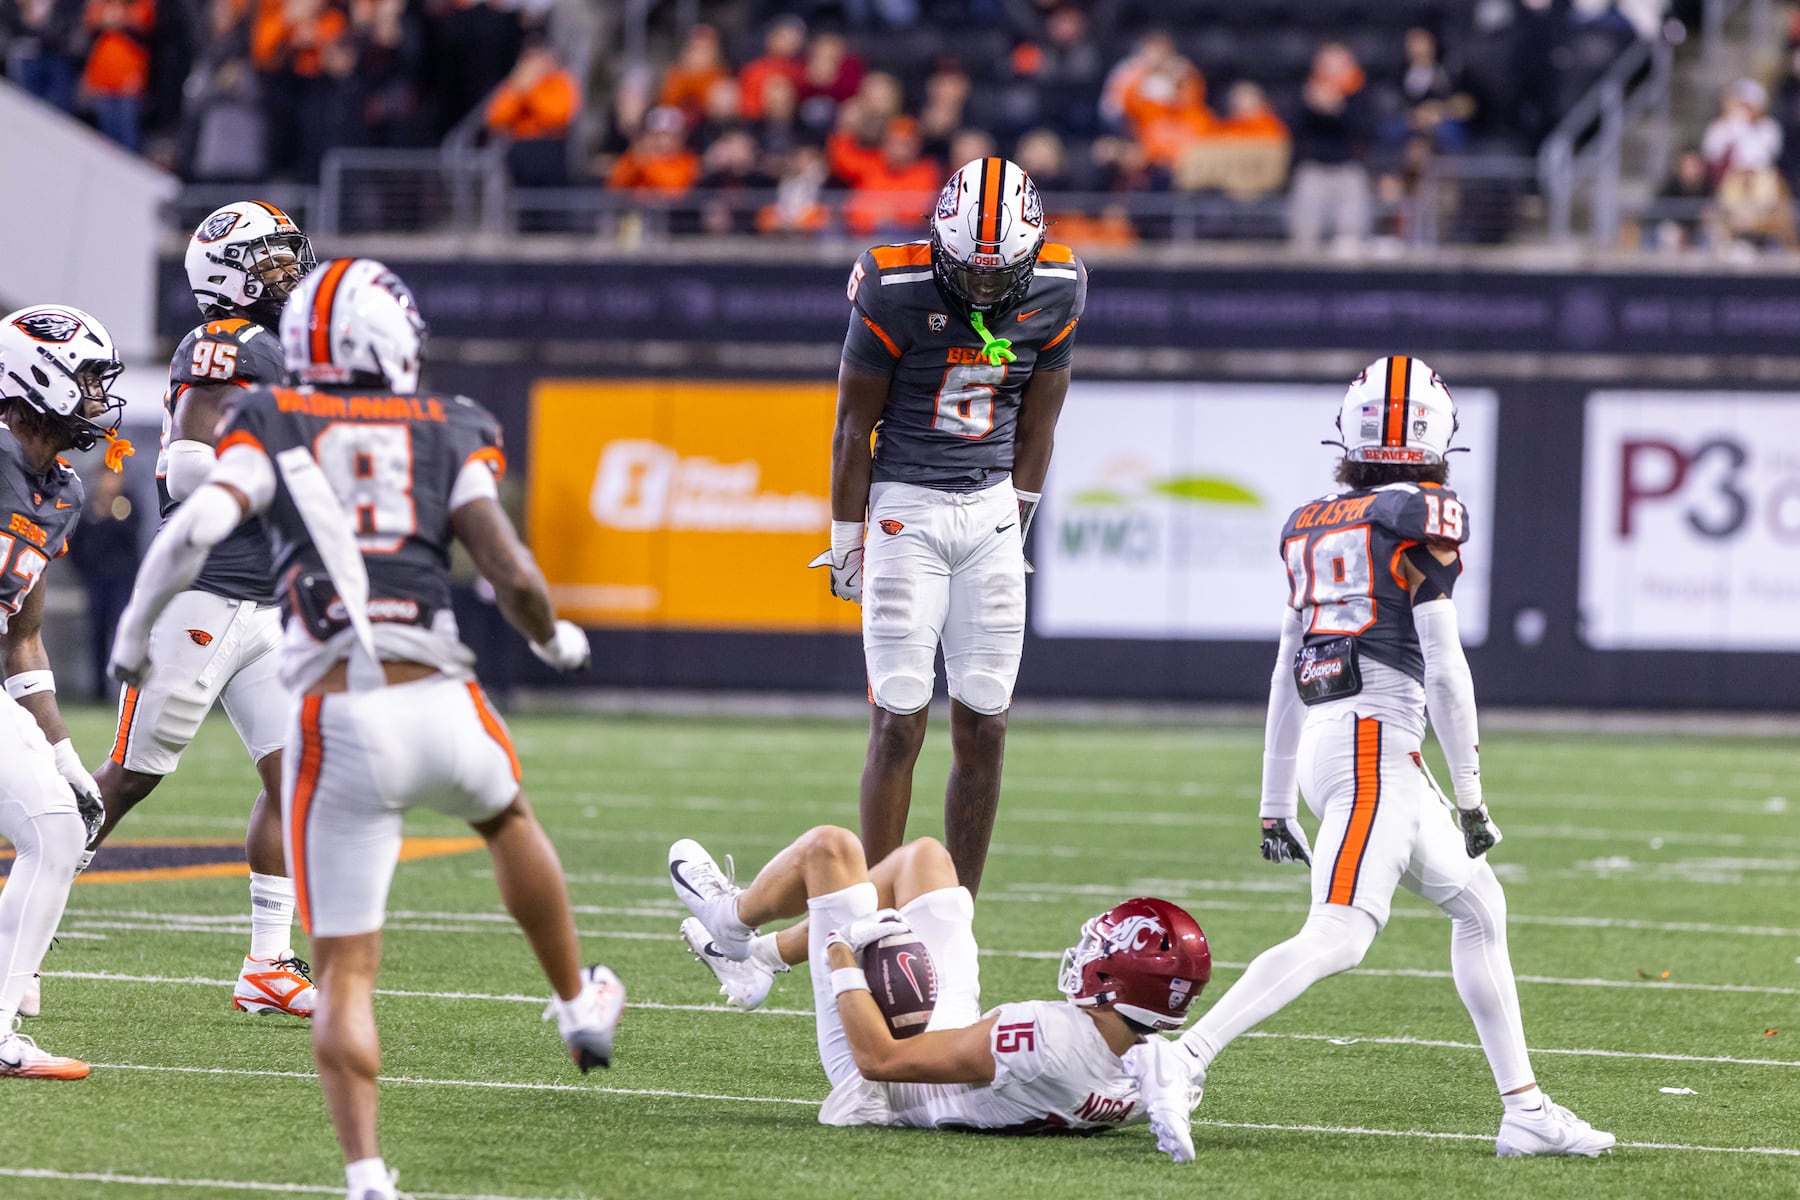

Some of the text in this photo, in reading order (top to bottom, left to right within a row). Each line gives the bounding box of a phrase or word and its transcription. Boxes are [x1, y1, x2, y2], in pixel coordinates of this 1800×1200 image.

[974, 256, 999, 266] OSU
[846, 262, 866, 302] 6
[192, 341, 238, 380] 95
[932, 363, 1009, 440] 6
[1364, 449, 1424, 462] BEAVERS
[314, 422, 416, 553] 8
[1618, 438, 1749, 541] P3
[1295, 494, 1377, 529] GLASPER
[1424, 495, 1463, 541] 19
[1285, 524, 1377, 637] 19
[1301, 659, 1342, 684] Beavers
[996, 1020, 1035, 1053] 15
[1074, 1092, 1135, 1123] NOGA
